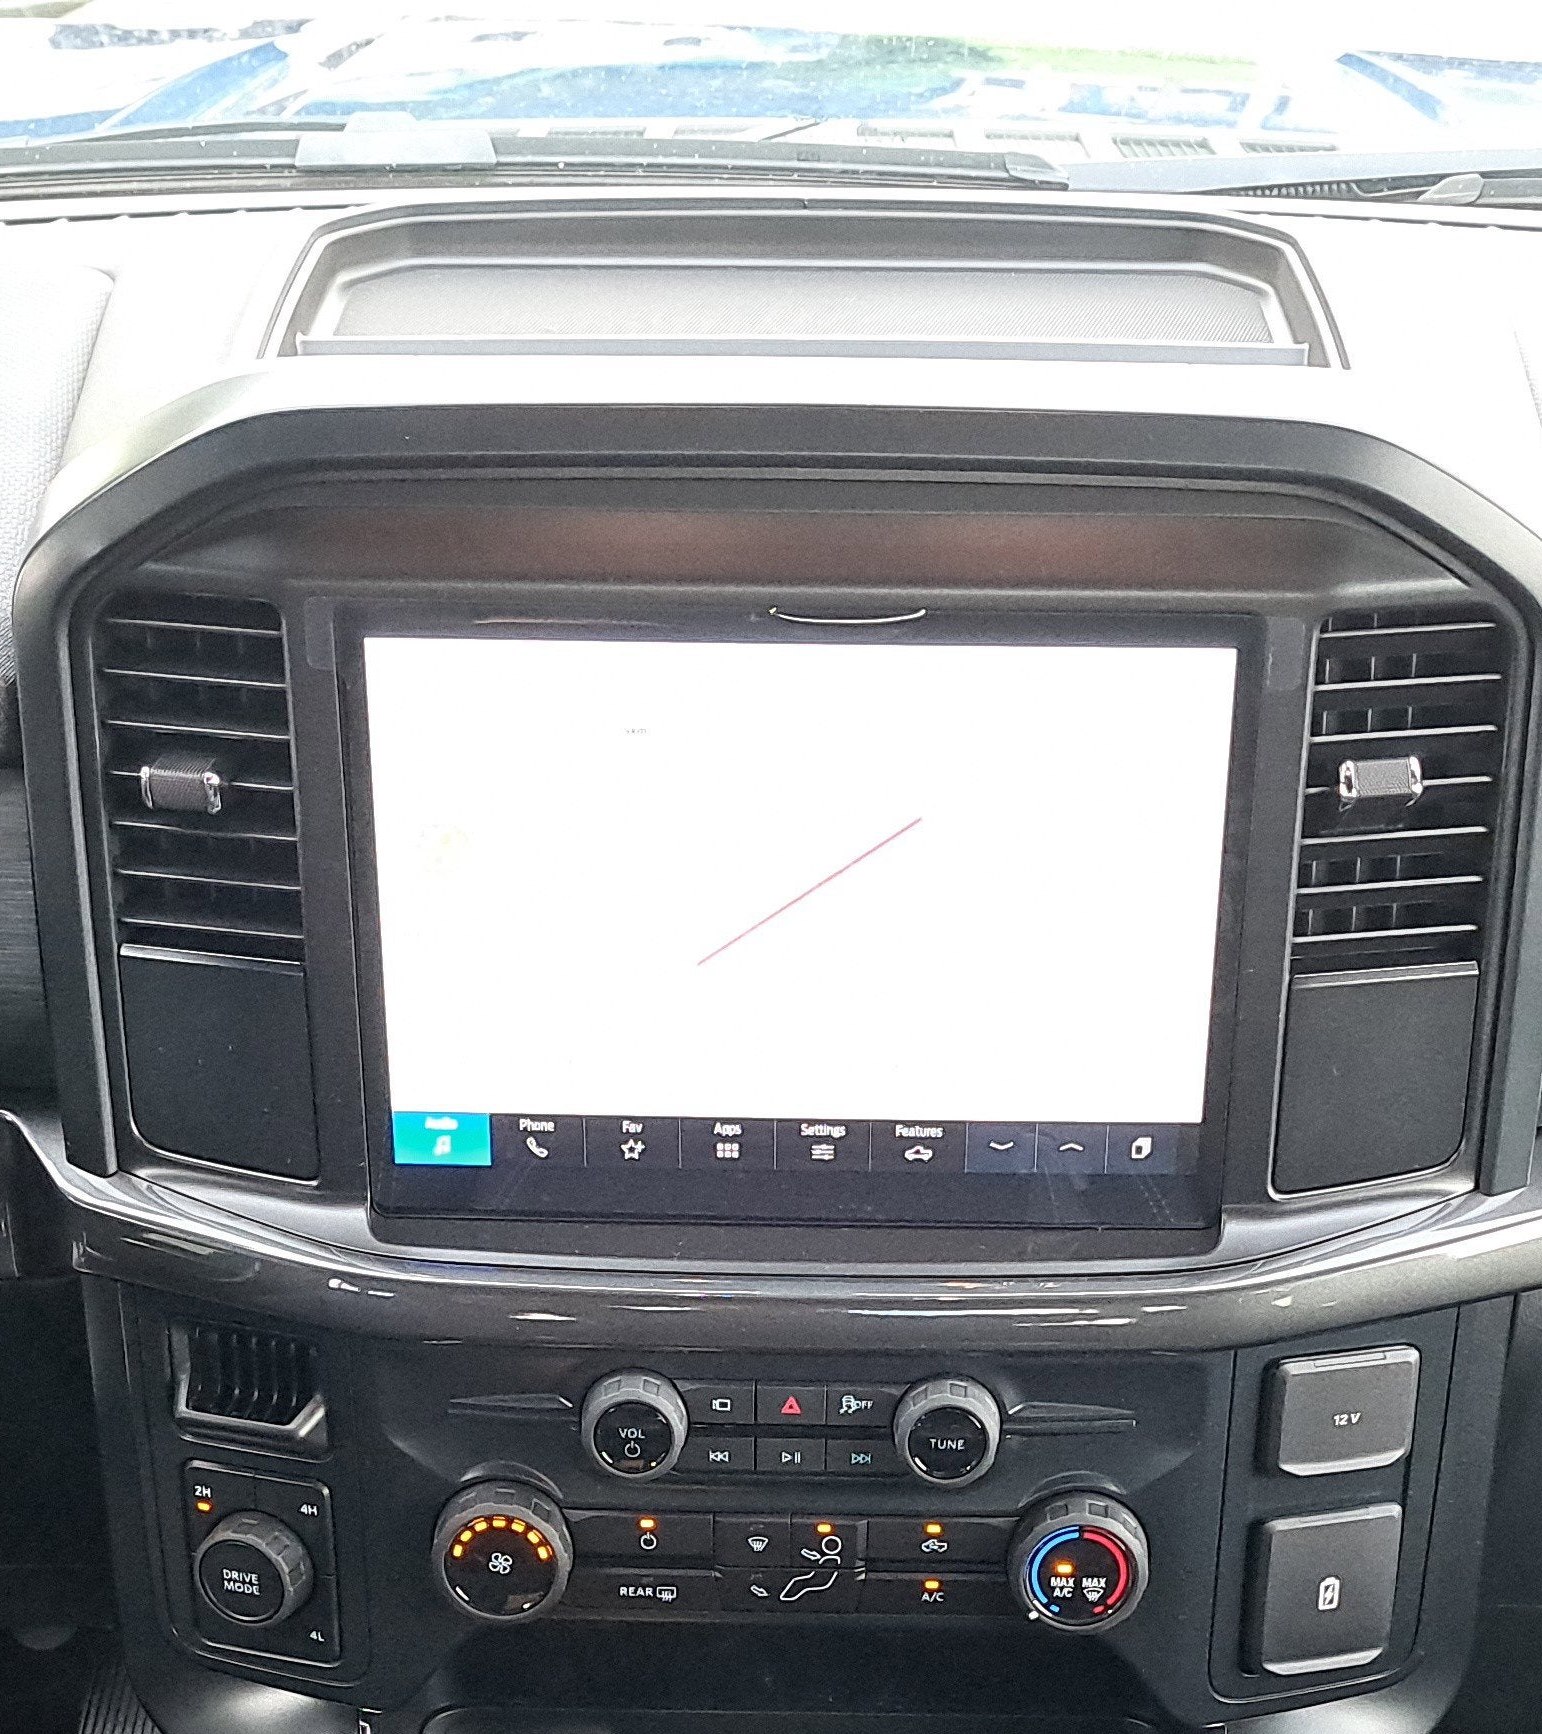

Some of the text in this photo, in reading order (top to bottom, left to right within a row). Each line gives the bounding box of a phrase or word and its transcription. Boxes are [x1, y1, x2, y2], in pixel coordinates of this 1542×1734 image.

[519, 1118, 555, 1133] Phone
[622, 1120, 643, 1135] Fav
[713, 1122, 742, 1137] Apps
[800, 1123, 846, 1139] Settings
[895, 1123, 943, 1139] Features
[619, 1428, 646, 1439] VOL
[929, 1438, 965, 1450] TUNE
[194, 1485, 211, 1498] 2H
[299, 1504, 318, 1516] 4H
[222, 1568, 258, 1583] DRIVE
[1050, 1576, 1074, 1587] MAX
[223, 1582, 260, 1595] MODE
[1082, 1577, 1107, 1588] MAX
[620, 1586, 653, 1597] REAR
[921, 1591, 945, 1602] A/C
[1053, 1587, 1073, 1598] A/C
[310, 1630, 325, 1642] 4L
